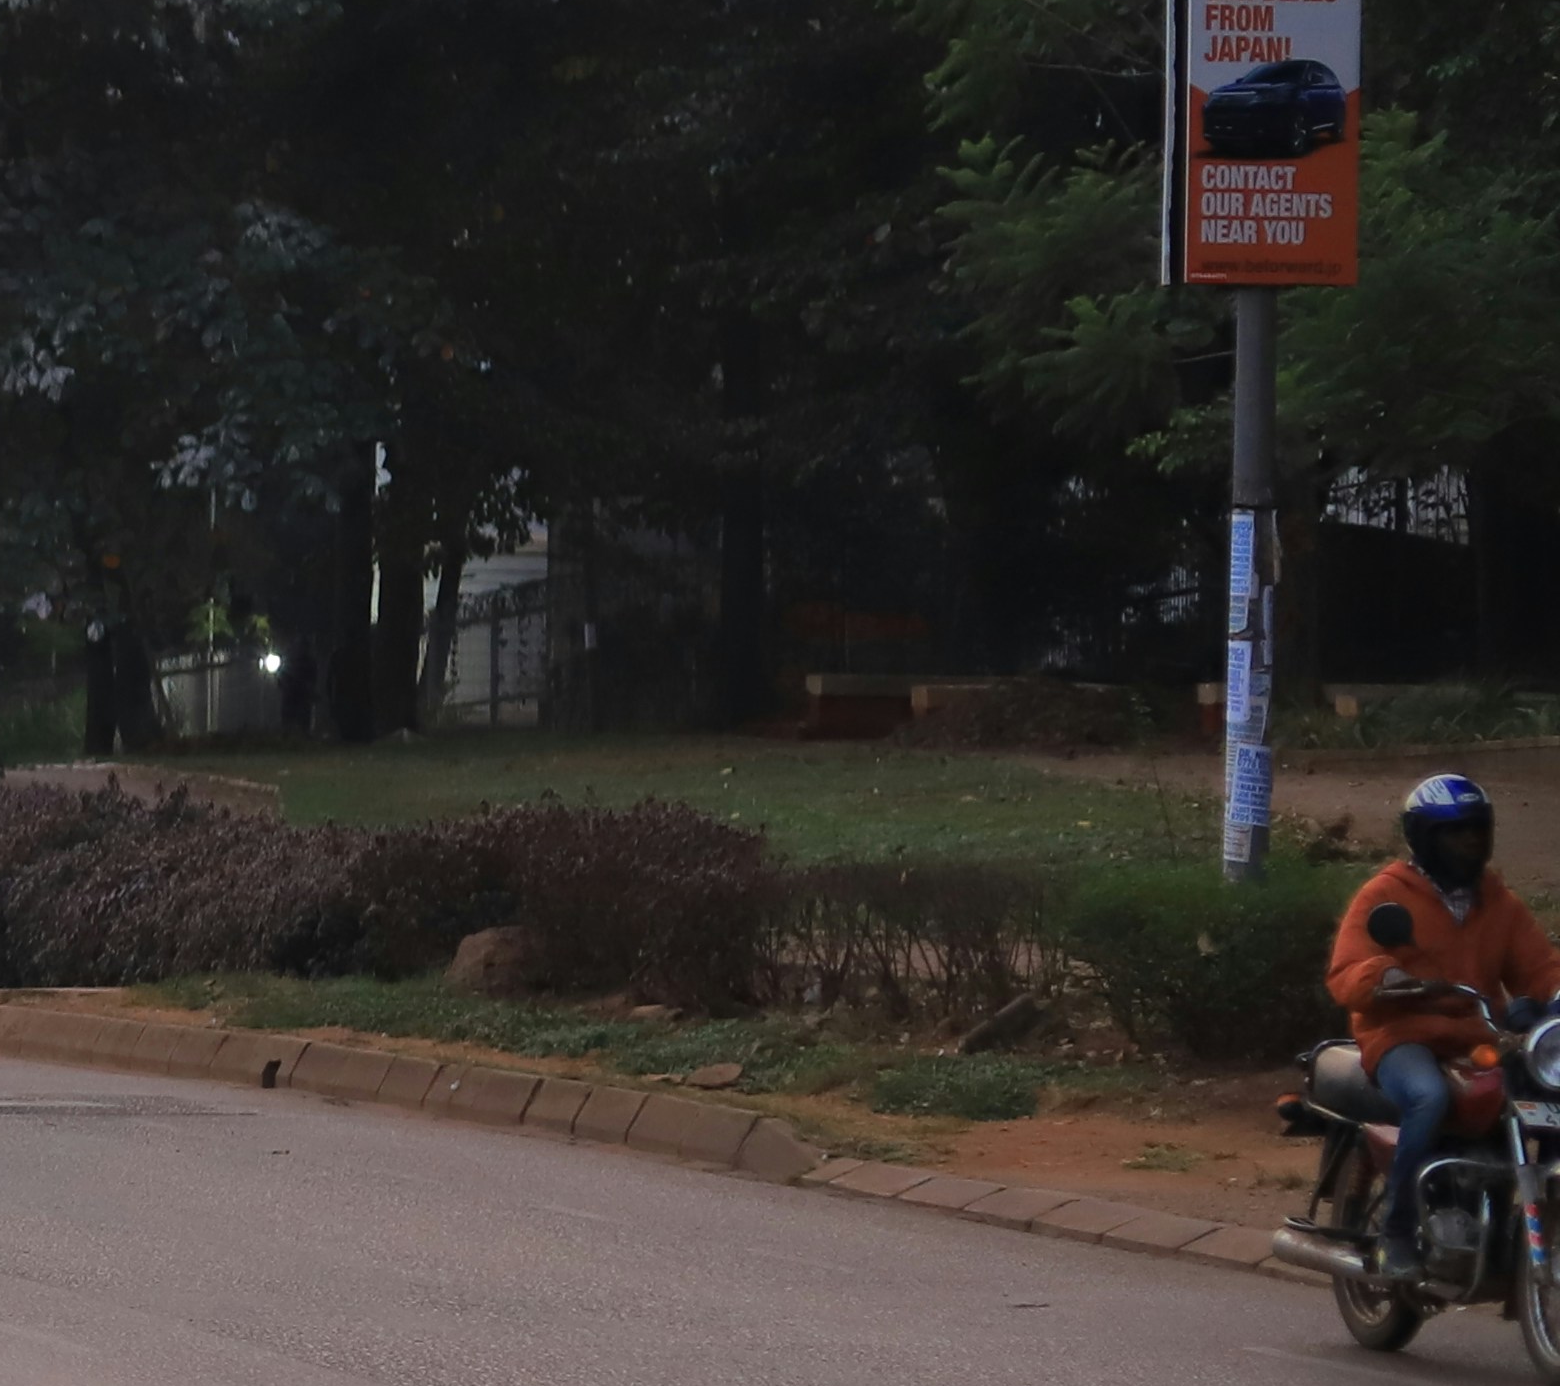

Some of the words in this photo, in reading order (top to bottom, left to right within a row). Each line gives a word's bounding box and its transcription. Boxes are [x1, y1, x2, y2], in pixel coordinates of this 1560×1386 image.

[1205, 4, 1274, 32] FROM
[1204, 35, 1292, 63] JAPAN!
[1201, 165, 1297, 191] CONTACT
[1201, 192, 1245, 217] OUR
[1249, 193, 1333, 219] AGENTS
[1201, 219, 1258, 244] NEAR
[1263, 220, 1305, 245] YOU
